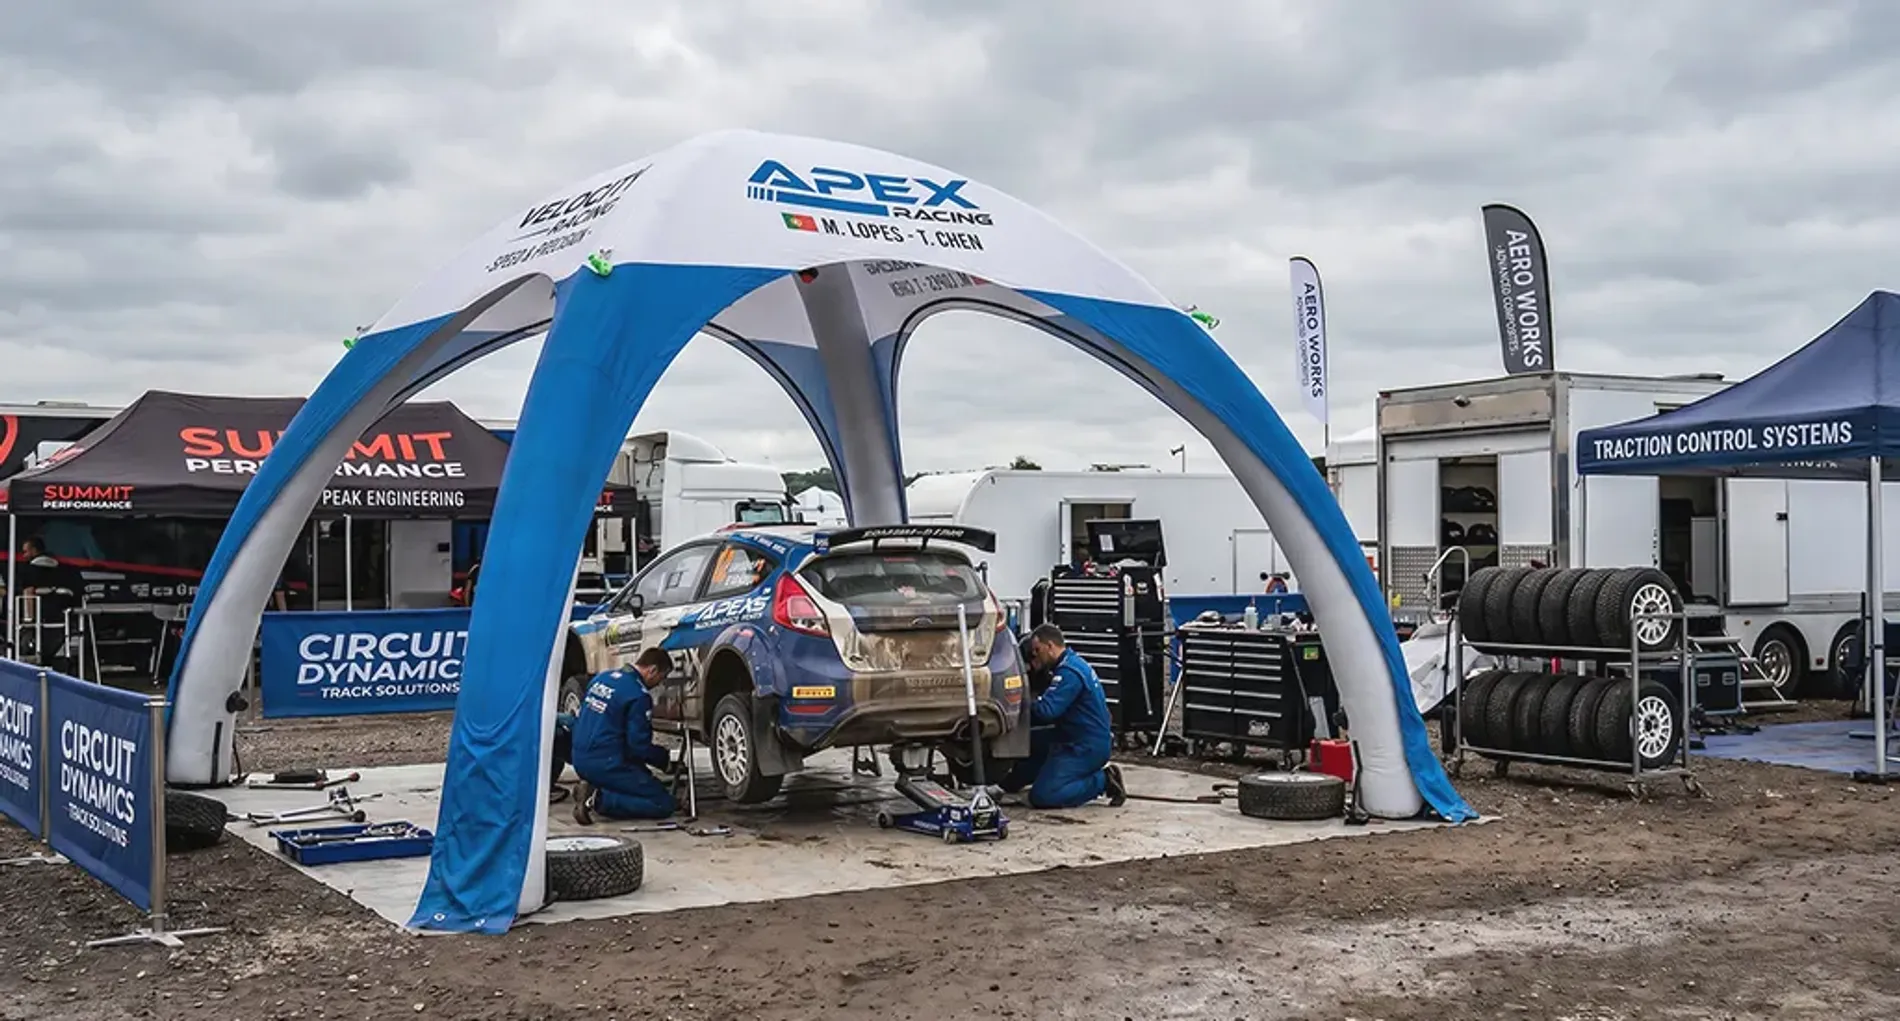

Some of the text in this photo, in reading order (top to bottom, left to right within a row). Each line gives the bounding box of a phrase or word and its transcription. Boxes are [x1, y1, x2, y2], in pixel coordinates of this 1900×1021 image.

[519, 163, 651, 229] VELOCITY
[748, 160, 980, 209] APEX
[893, 206, 993, 226] RACING
[820, 217, 845, 236] M.
[847, 220, 905, 243] LOPES
[916, 228, 935, 246] T.
[936, 230, 984, 251] CHEN
[1506, 230, 1543, 366] AERO WORKS
[1304, 282, 1323, 398] AERO WORKS
[180, 426, 452, 460] SUMIT
[1594, 421, 1852, 460] TRACTION CONTROL SYSTEMS
[185, 458, 465, 477] PERMANCE
[42, 500, 133, 509] PERFORMANCE
[44, 485, 134, 500] SUMMIT
[323, 489, 465, 507] PEAK ENGINEERING
[297, 659, 463, 684] DYNAMIC
[320, 681, 460, 699] TRACK SOLUTIONS
[61, 720, 136, 784] CIRCUIT
[61, 762, 135, 824] DYNAMICS
